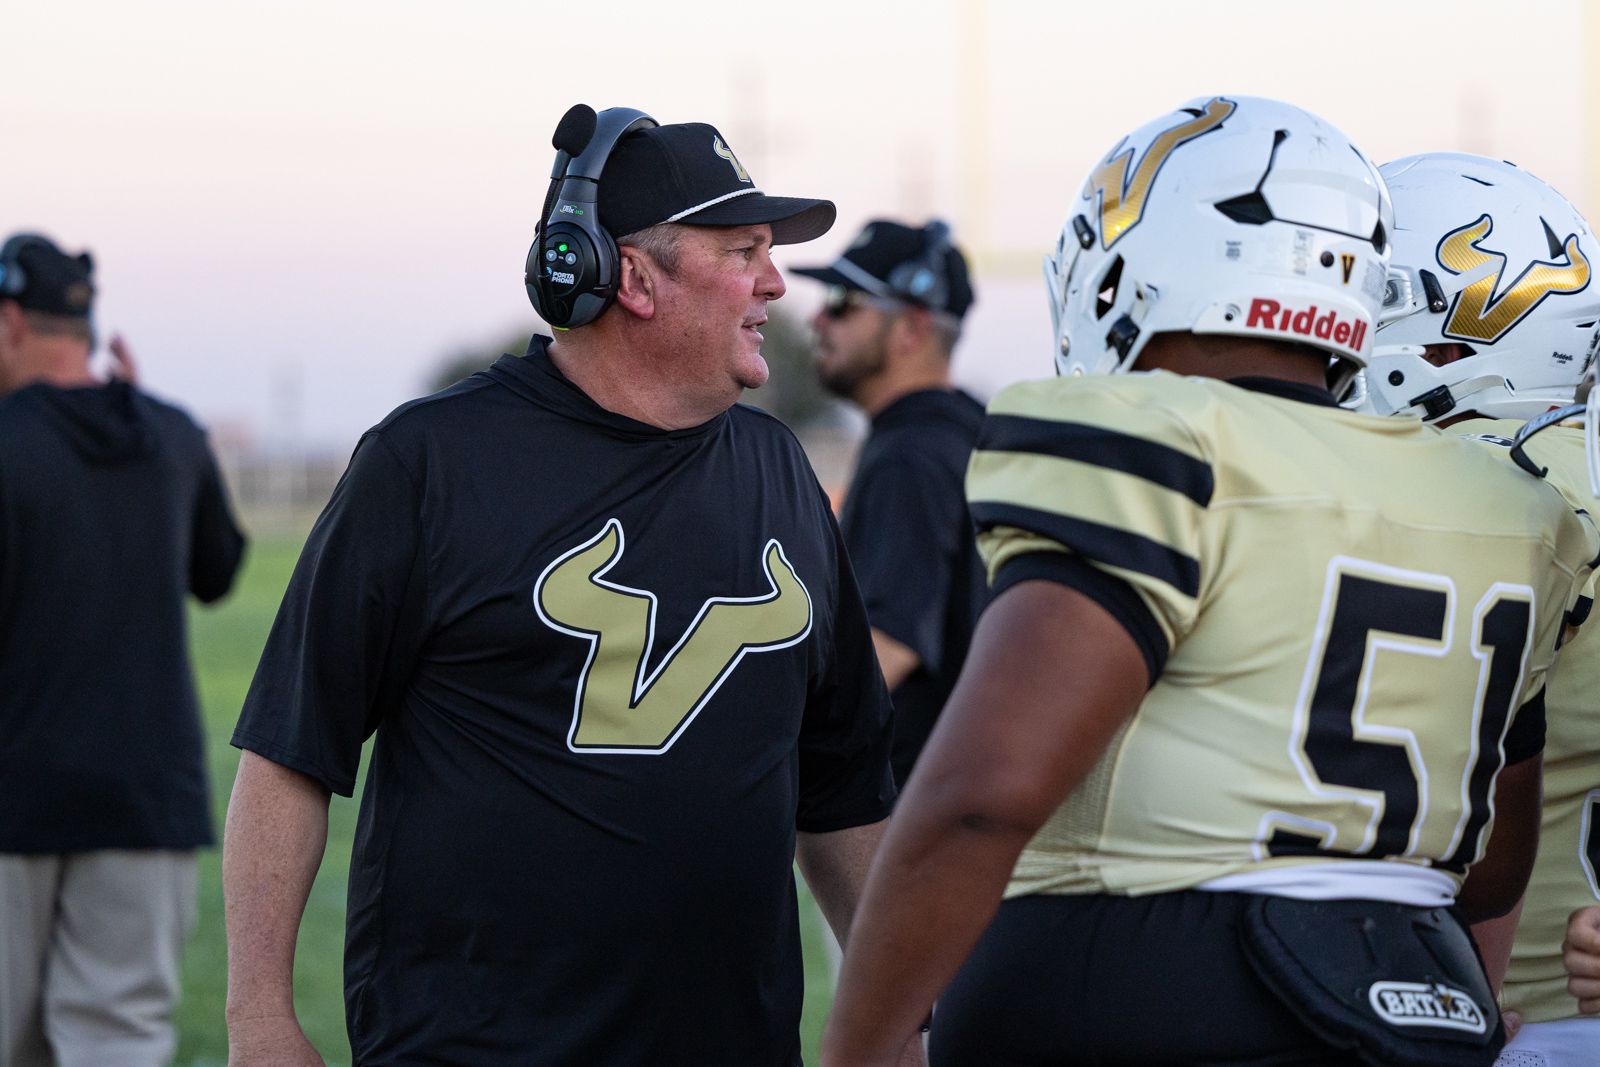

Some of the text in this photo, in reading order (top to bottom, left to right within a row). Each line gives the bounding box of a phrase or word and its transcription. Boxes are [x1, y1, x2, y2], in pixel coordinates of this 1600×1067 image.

[551, 277, 574, 285] PHONE
[552, 271, 574, 279] PORTA
[1340, 253, 1356, 285] V
[1245, 298, 1368, 352] Riddell
[1253, 555, 1535, 872] 51
[1380, 991, 1479, 1025] BATTLE
